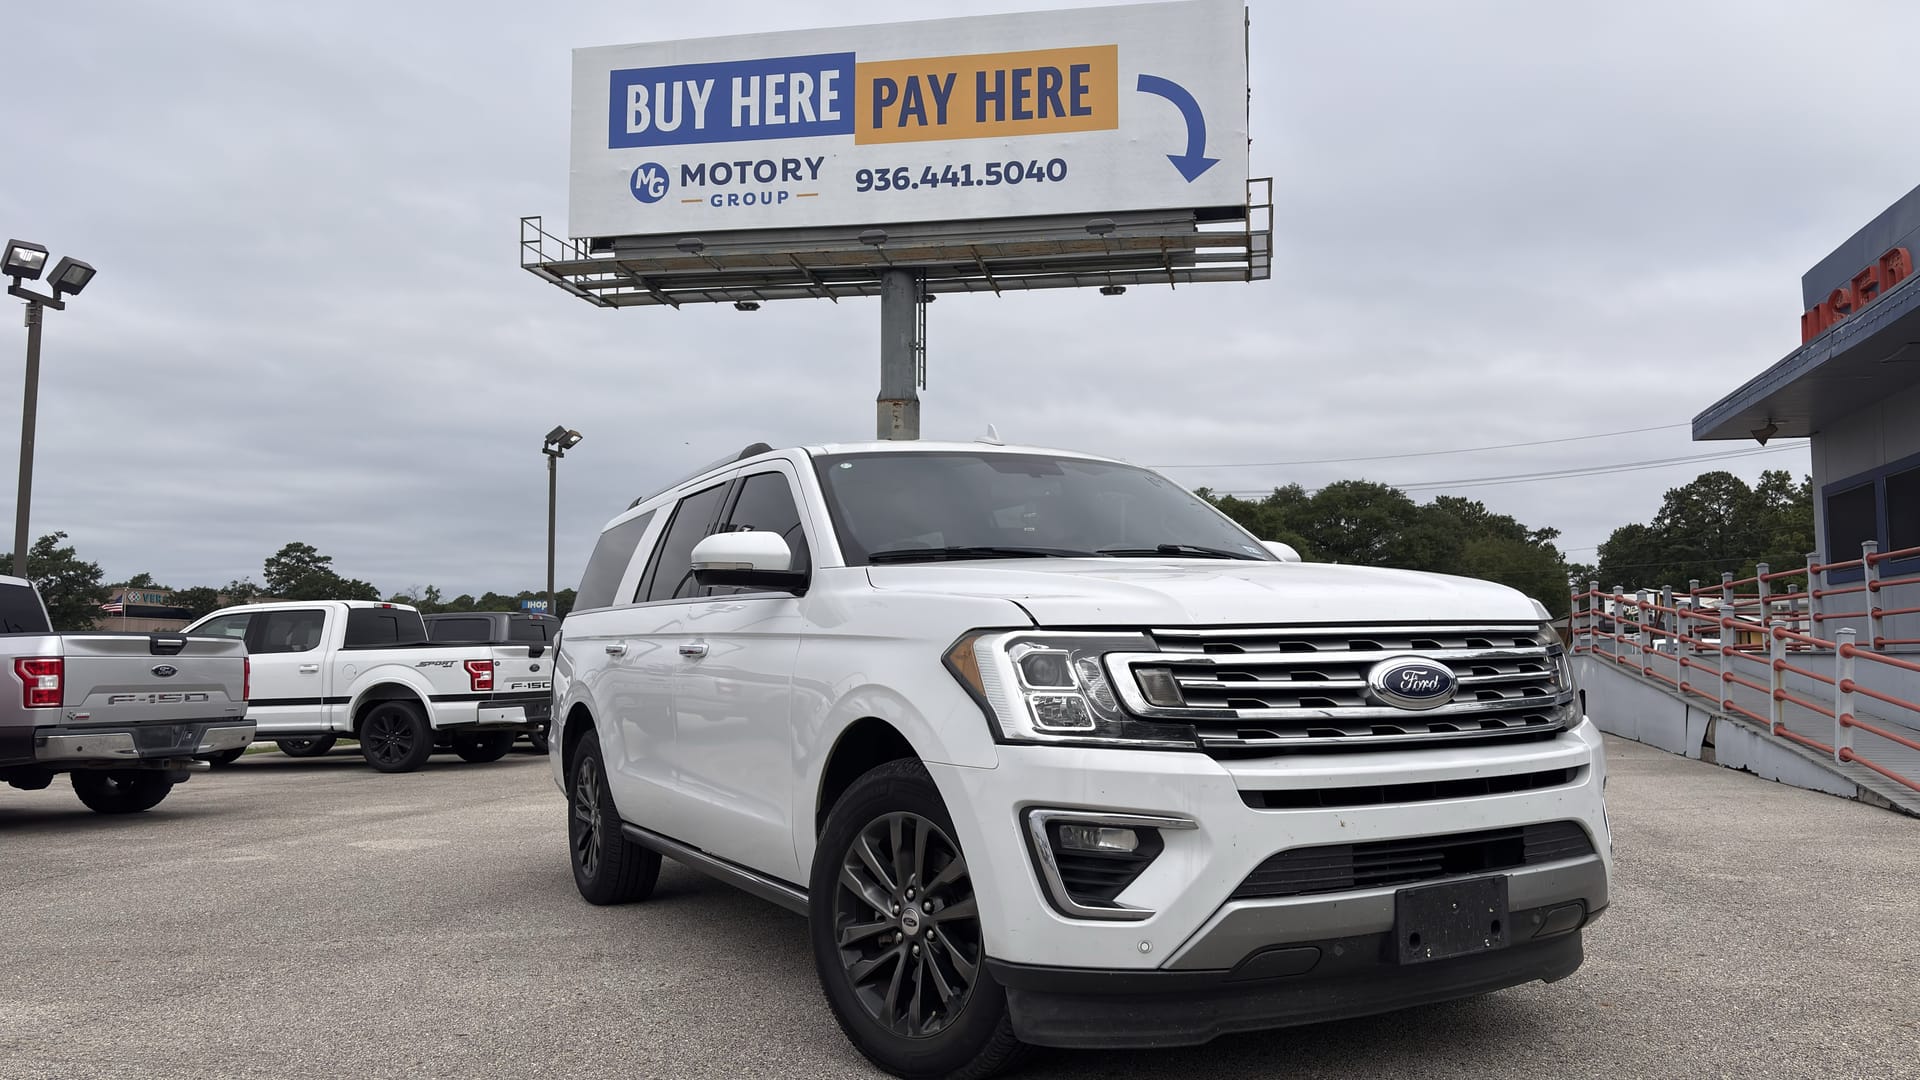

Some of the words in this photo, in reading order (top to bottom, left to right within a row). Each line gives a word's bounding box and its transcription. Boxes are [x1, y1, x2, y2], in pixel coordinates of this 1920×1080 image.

[626, 79, 715, 134] BUY
[731, 69, 841, 128] HERE
[872, 72, 957, 129] PAY
[975, 63, 1092, 123] HERE
[635, 167, 665, 198] MG
[680, 156, 825, 187] MOTORY
[855, 158, 1068, 192] 936.441.5040
[710, 190, 789, 207] GROUP
[1400, 670, 1440, 690] Ford
[108, 693, 209, 705] F-150
